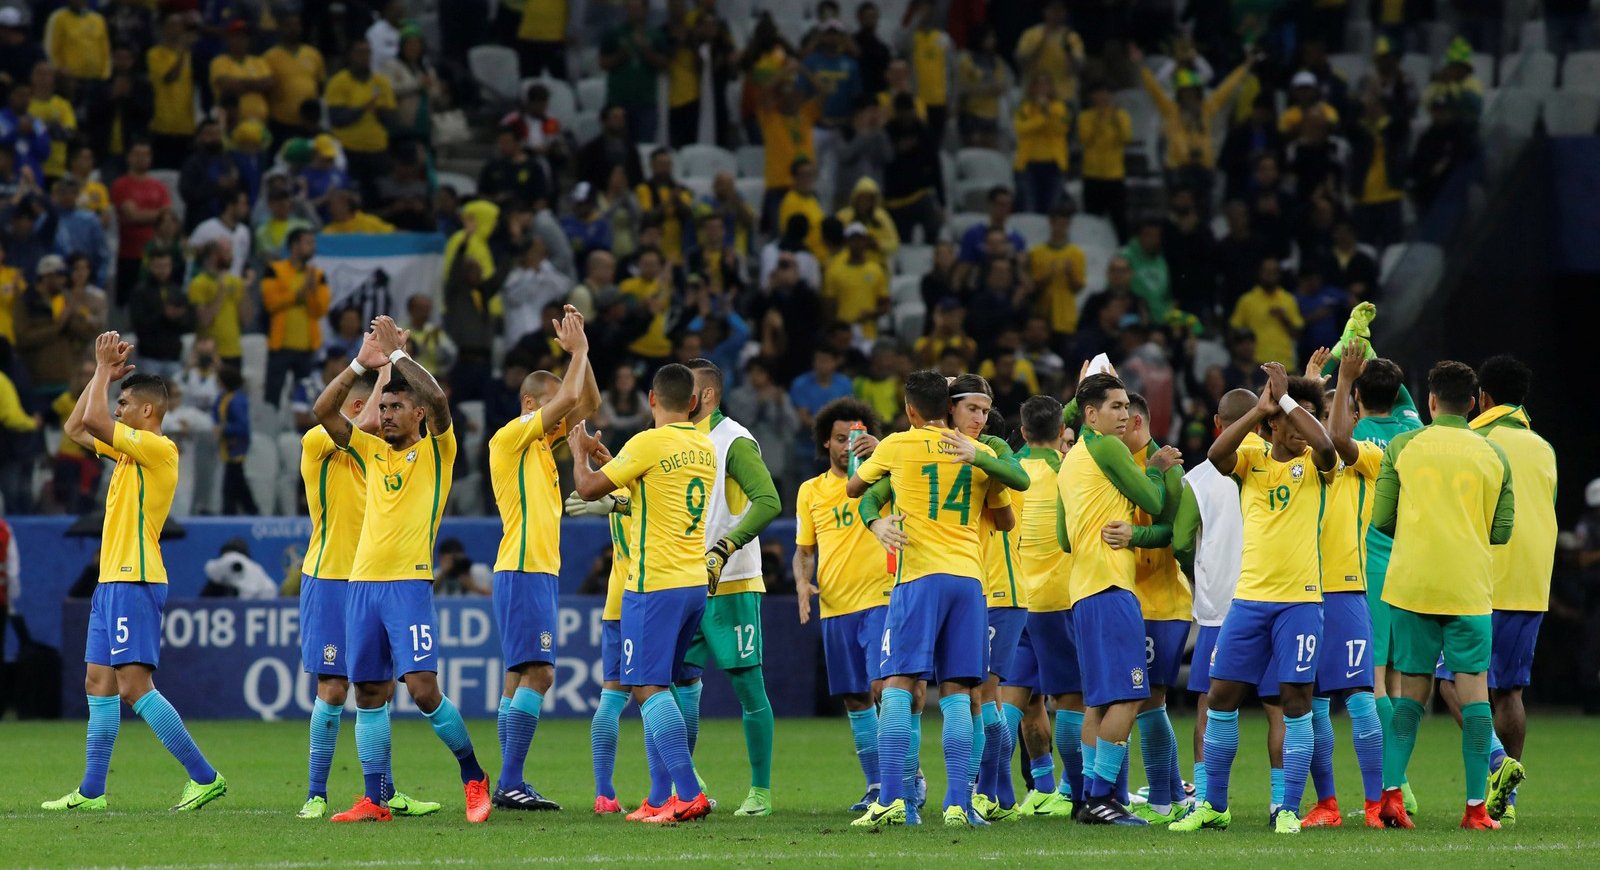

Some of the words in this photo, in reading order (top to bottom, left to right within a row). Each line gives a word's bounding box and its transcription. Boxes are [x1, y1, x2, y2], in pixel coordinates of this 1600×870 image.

[660, 449, 695, 473] DIEGO
[685, 477, 706, 535] 9
[921, 462, 972, 526] 14
[1268, 485, 1291, 511] 19
[832, 502, 854, 529] 16
[116, 616, 129, 643] 5
[245, 608, 301, 647] FIF
[409, 624, 433, 651] 15
[734, 624, 755, 651] 12
[624, 638, 634, 666] 9
[1296, 634, 1317, 662] 19
[1346, 640, 1367, 667] 17
